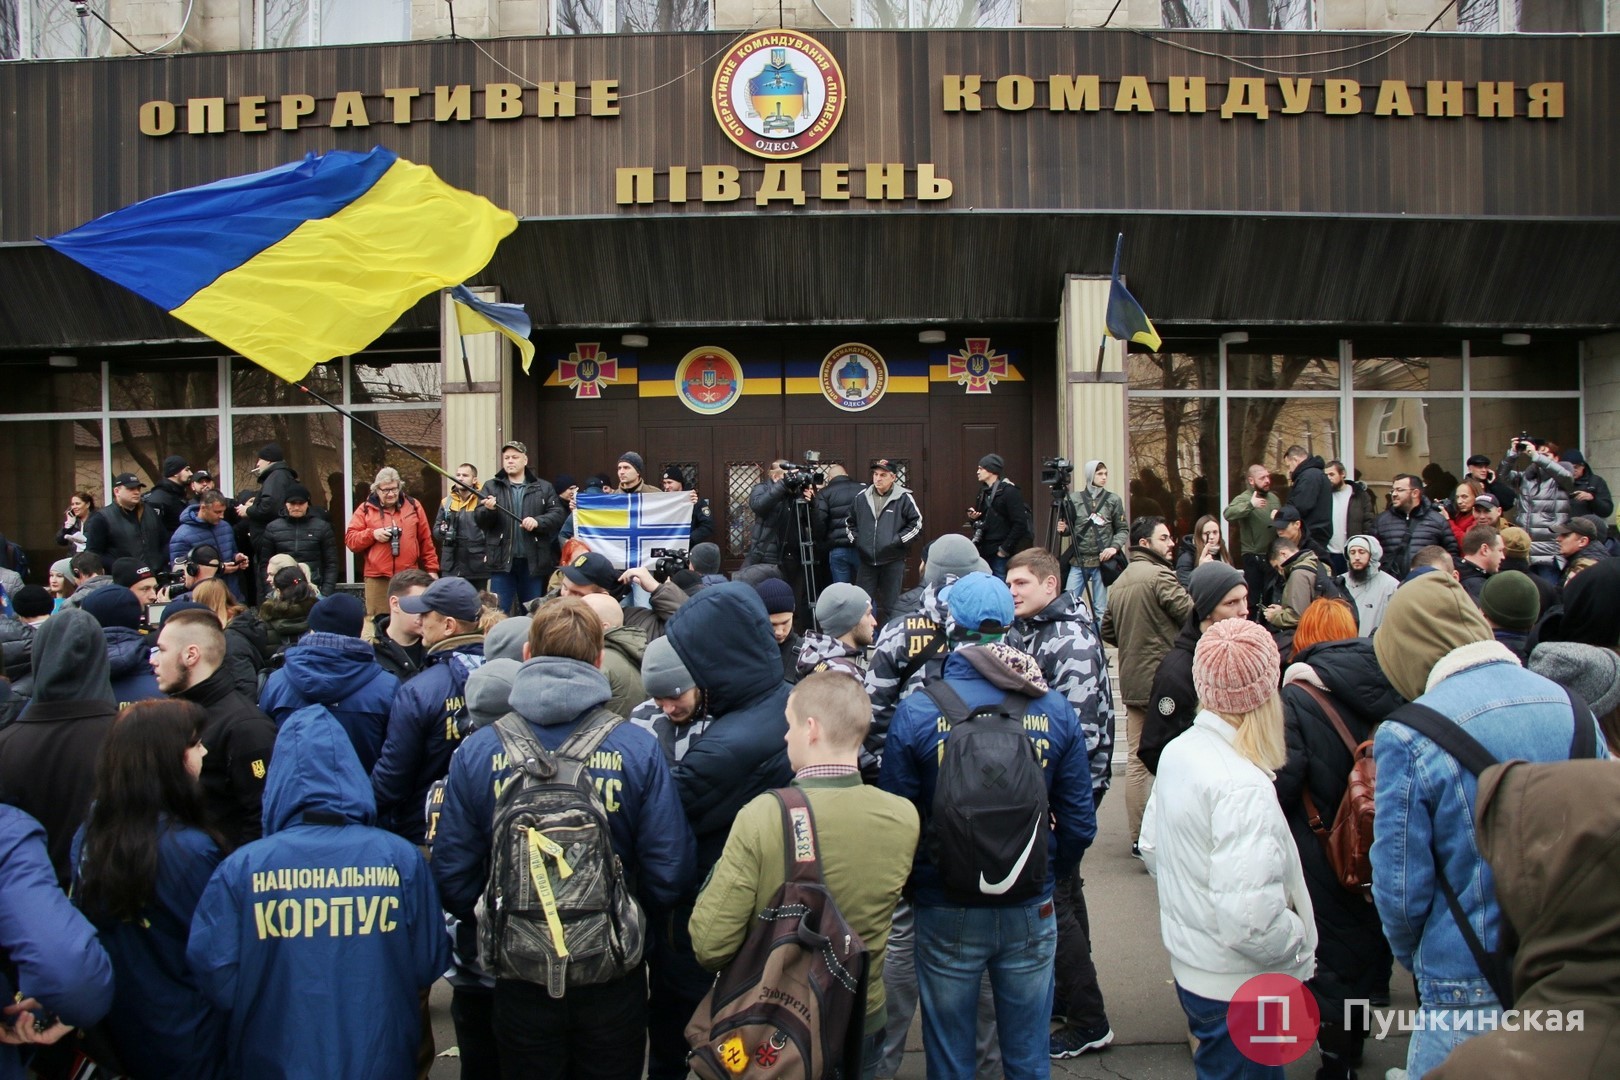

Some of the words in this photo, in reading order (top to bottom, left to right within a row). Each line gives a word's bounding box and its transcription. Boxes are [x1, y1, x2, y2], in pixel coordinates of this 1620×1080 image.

[139, 79, 622, 137] ОПЕРАТИВНЕ
[942, 73, 1566, 121] КОМАНДУВАННЯ
[717, 59, 745, 137] ОПЕРАТИВНЕ
[737, 36, 830, 71] КОМАНДУВАННЯ
[755, 139, 800, 153] ОДЕСА
[615, 162, 954, 207] ПІВДЕНЬ
[843, 400, 866, 408] ОДЕСА
[252, 863, 400, 893] НАЦІОНАЛЬНИЙ
[254, 896, 400, 940] КОРПУС
